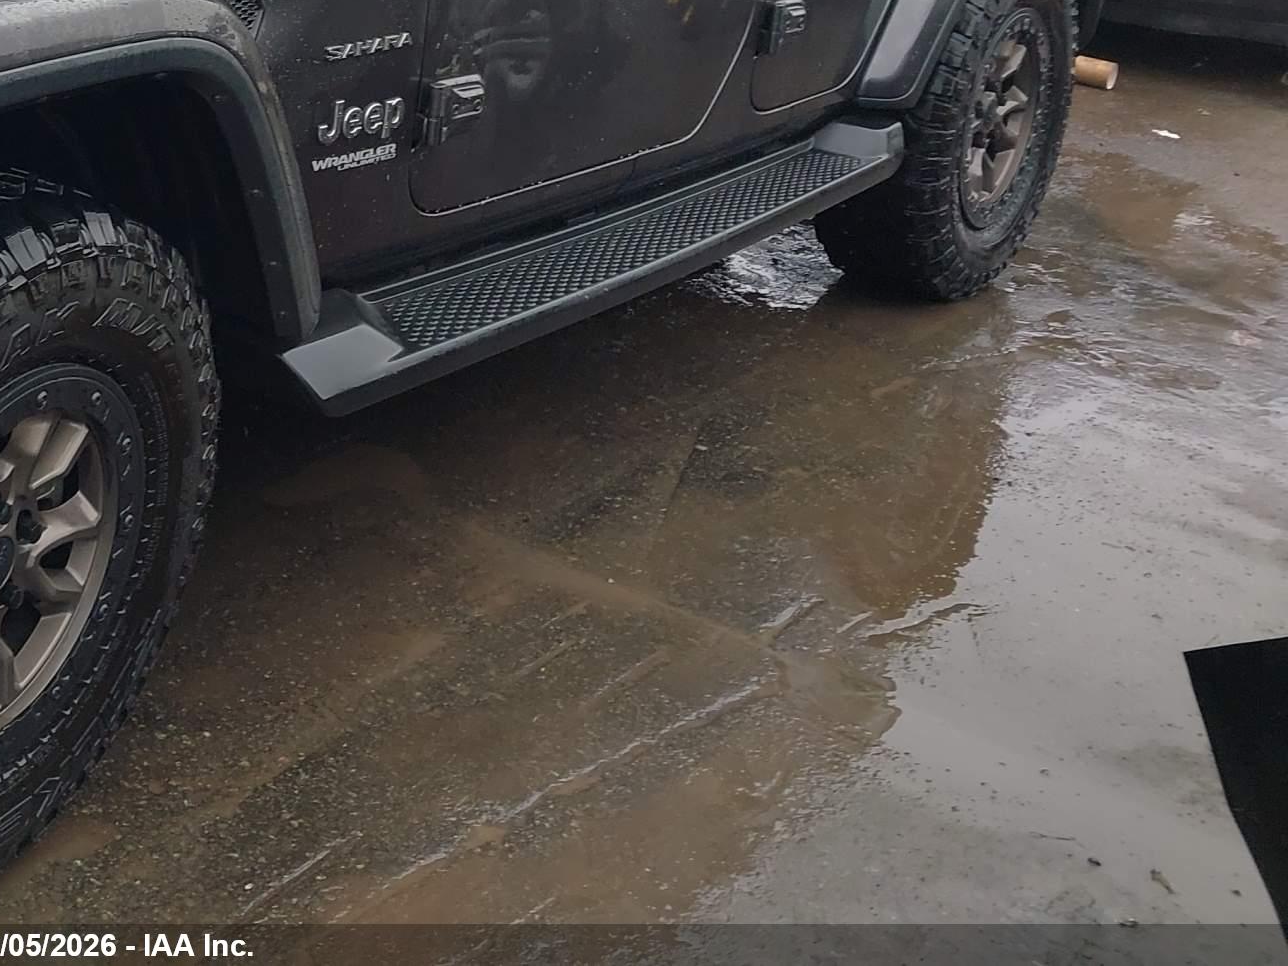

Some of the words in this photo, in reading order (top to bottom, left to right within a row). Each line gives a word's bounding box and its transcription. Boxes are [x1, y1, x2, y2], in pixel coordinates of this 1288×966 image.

[324, 32, 411, 61] SAHARA
[318, 97, 405, 144] Jeep
[312, 143, 397, 172] WRANGLER
[337, 153, 396, 171] UNLIMITED
